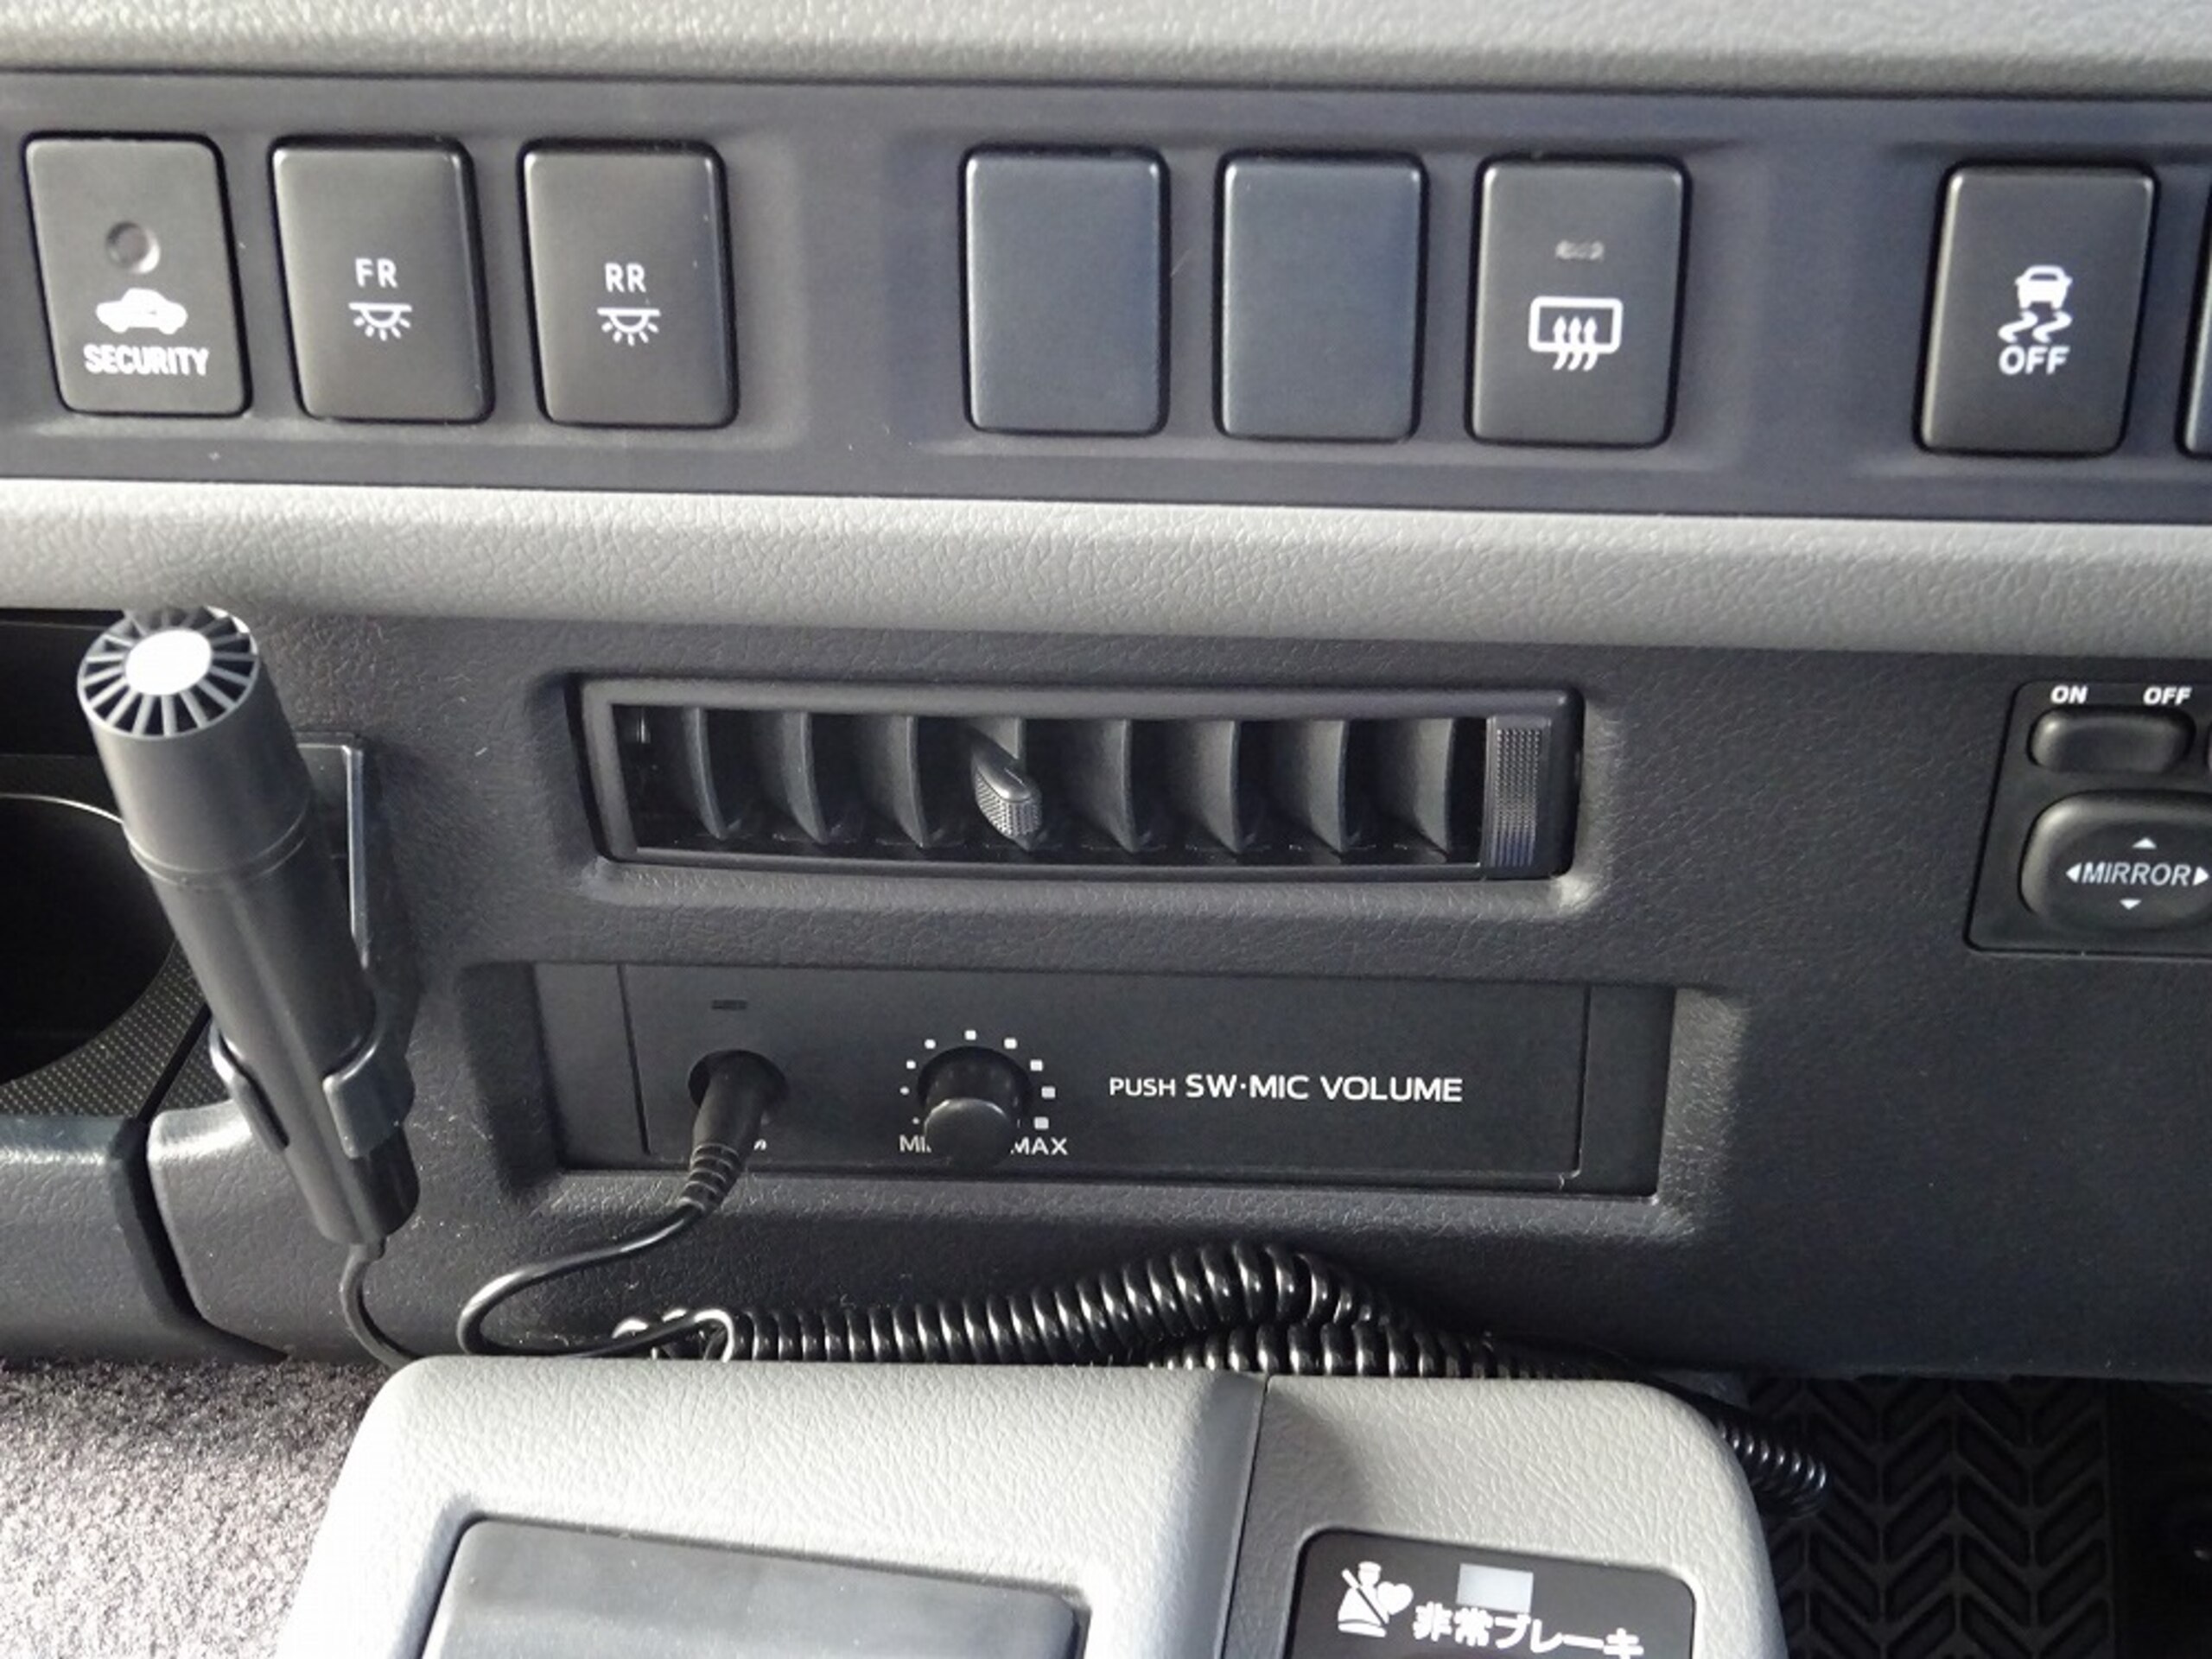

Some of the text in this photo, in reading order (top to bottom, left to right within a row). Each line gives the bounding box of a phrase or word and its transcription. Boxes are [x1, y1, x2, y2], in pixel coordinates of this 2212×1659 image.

[354, 257, 398, 289] FR
[604, 262, 647, 293] RR
[82, 344, 211, 377] SECURITY
[1998, 346, 2070, 375] OFF
[2050, 685, 2088, 704] ON
[2143, 686, 2193, 705] OFF
[2081, 861, 2192, 887] MIRROR
[1109, 1077, 1176, 1097] PUSH
[1319, 1075, 1464, 1103] VOLUME
[899, 1135, 932, 1154] MI
[1010, 1136, 1068, 1156] MAX
